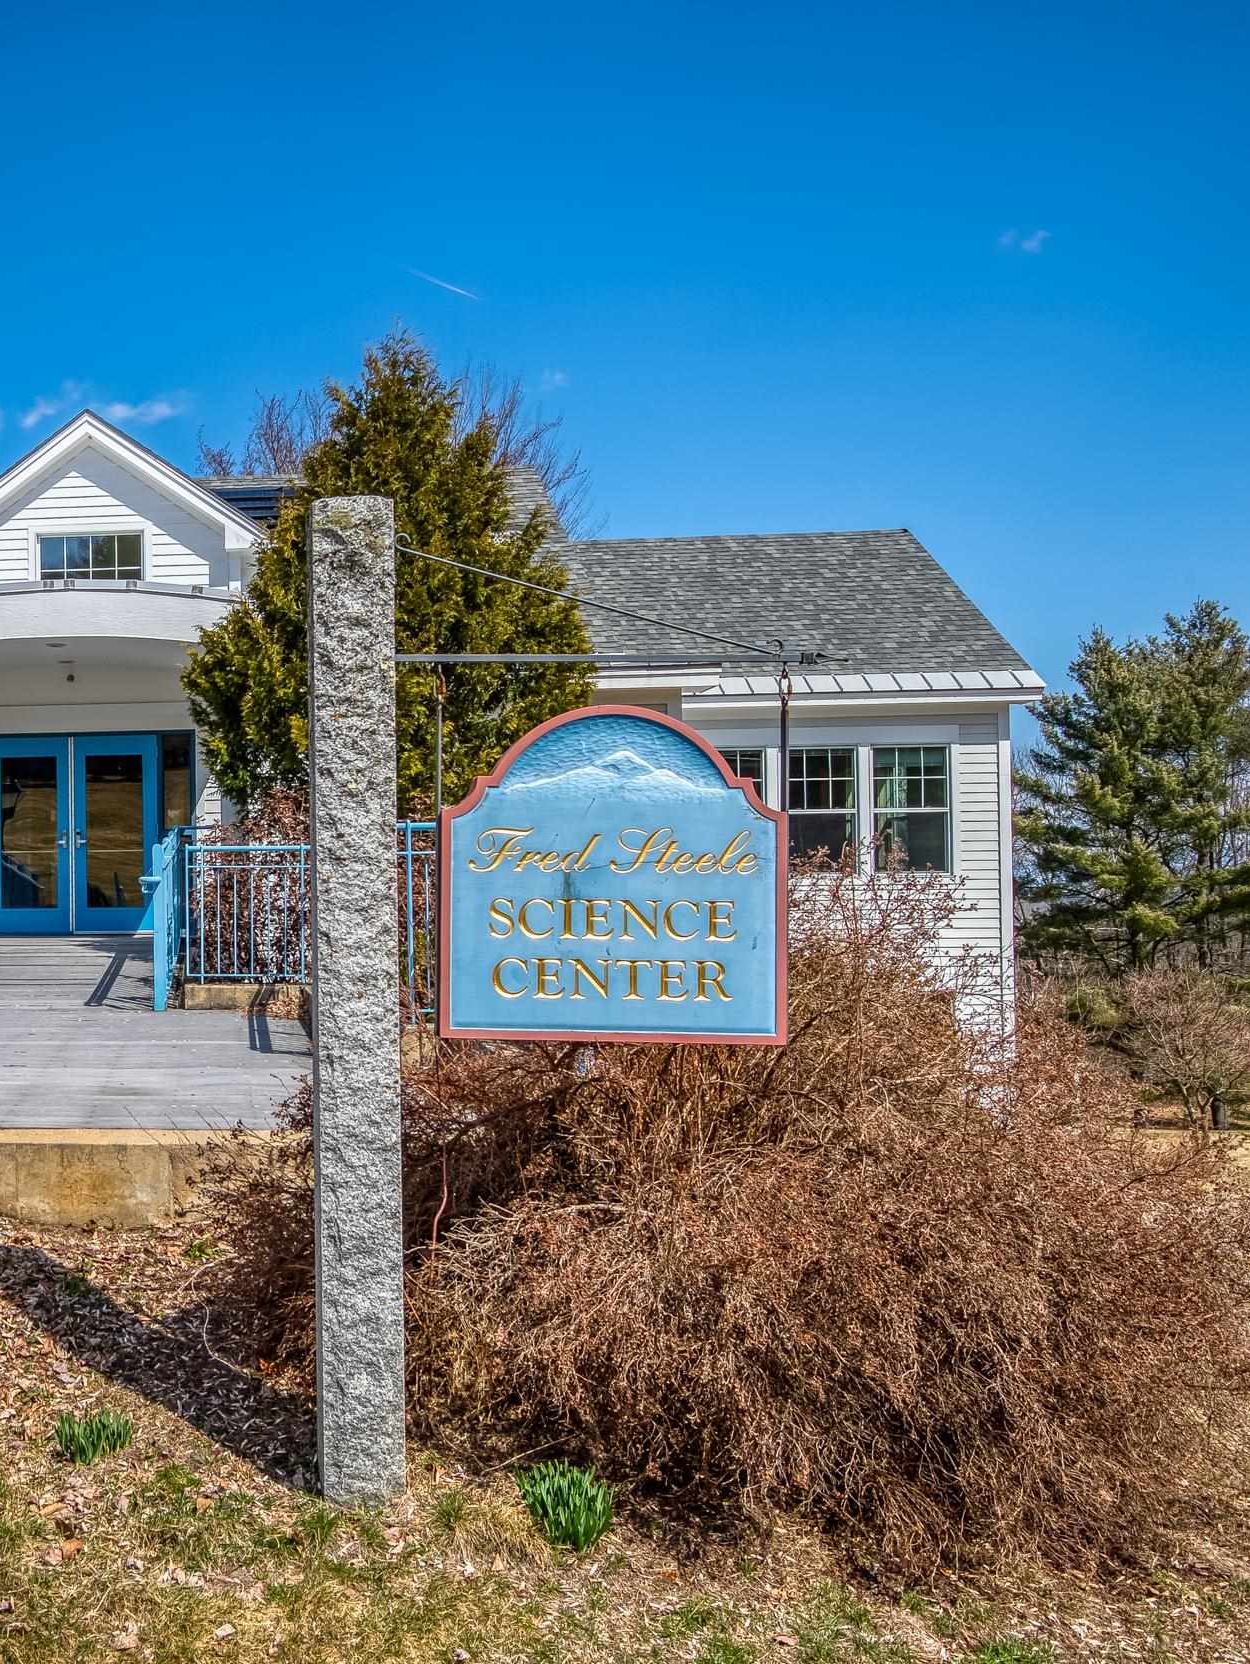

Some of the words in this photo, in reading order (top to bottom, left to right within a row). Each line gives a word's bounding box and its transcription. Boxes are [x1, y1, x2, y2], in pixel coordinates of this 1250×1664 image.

[468, 826, 601, 873] Fred
[609, 828, 759, 875] Steele
[489, 898, 738, 942] SCIENCE
[492, 957, 734, 1001] CENTER
